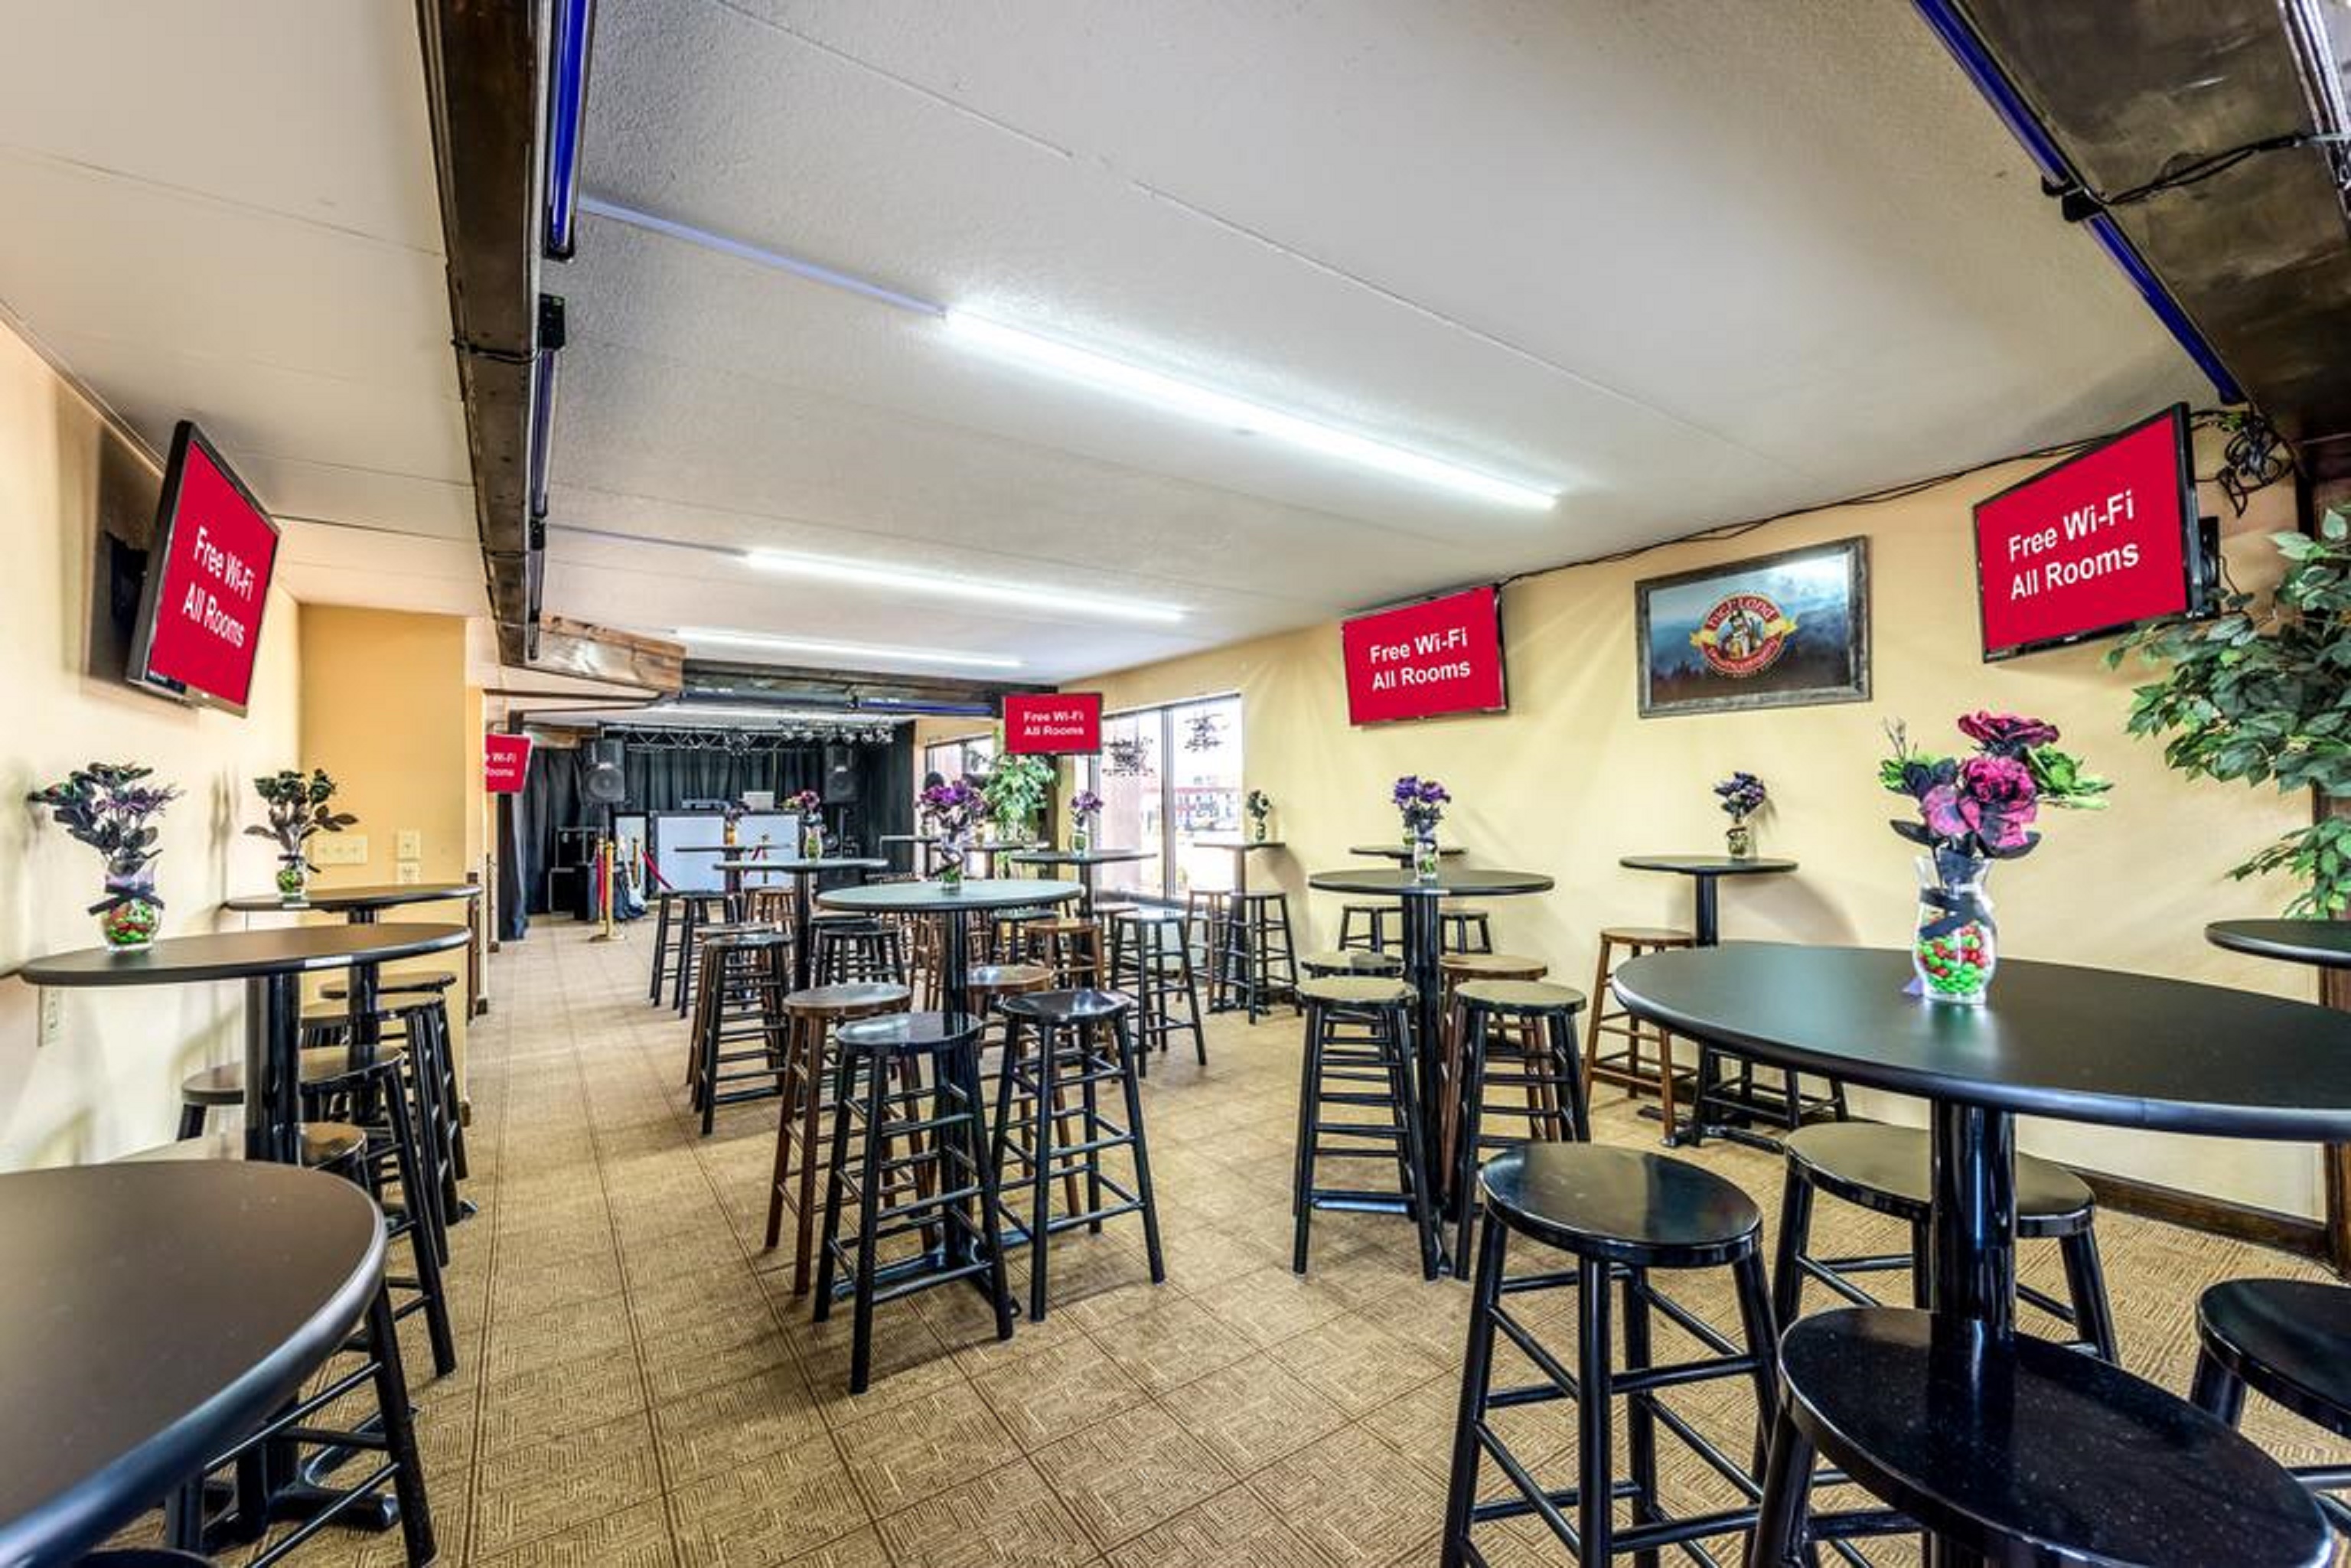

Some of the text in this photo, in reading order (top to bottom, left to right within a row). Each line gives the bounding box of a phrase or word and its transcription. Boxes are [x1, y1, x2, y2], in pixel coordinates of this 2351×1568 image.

[2009, 490, 2134, 562] Free Wi-Fi
[194, 526, 254, 600] Free Wi-Fi
[2011, 543, 2139, 600] All Rooms
[183, 582, 244, 647] All Rooms
[1370, 627, 1467, 663] Free Wi-Fi
[1372, 661, 1470, 690] All Rooms
[1024, 711, 1083, 722] Free Wi-Fi
[1024, 725, 1084, 735] All Rooms
[492, 753, 516, 762] Wi-Fi
